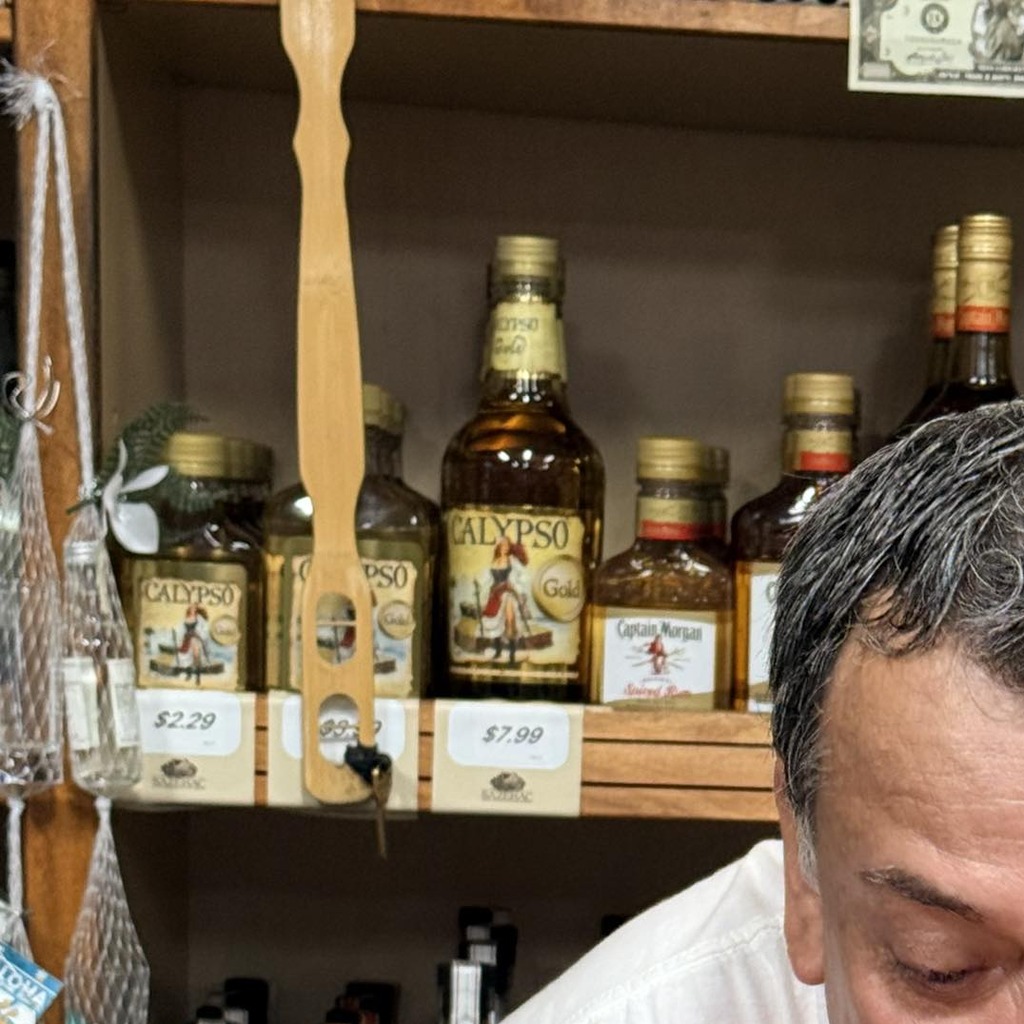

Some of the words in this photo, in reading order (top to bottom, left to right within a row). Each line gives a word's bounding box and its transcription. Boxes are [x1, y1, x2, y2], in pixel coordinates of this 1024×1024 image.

[452, 514, 569, 550] CALYPSO
[144, 582, 235, 606] CALYPSO
[543, 579, 581, 598] Gold
[617, 618, 658, 641] Captain
[660, 621, 703, 642] Morgan
[154, 710, 217, 731] $2.29
[482, 724, 545, 744] $7.99
